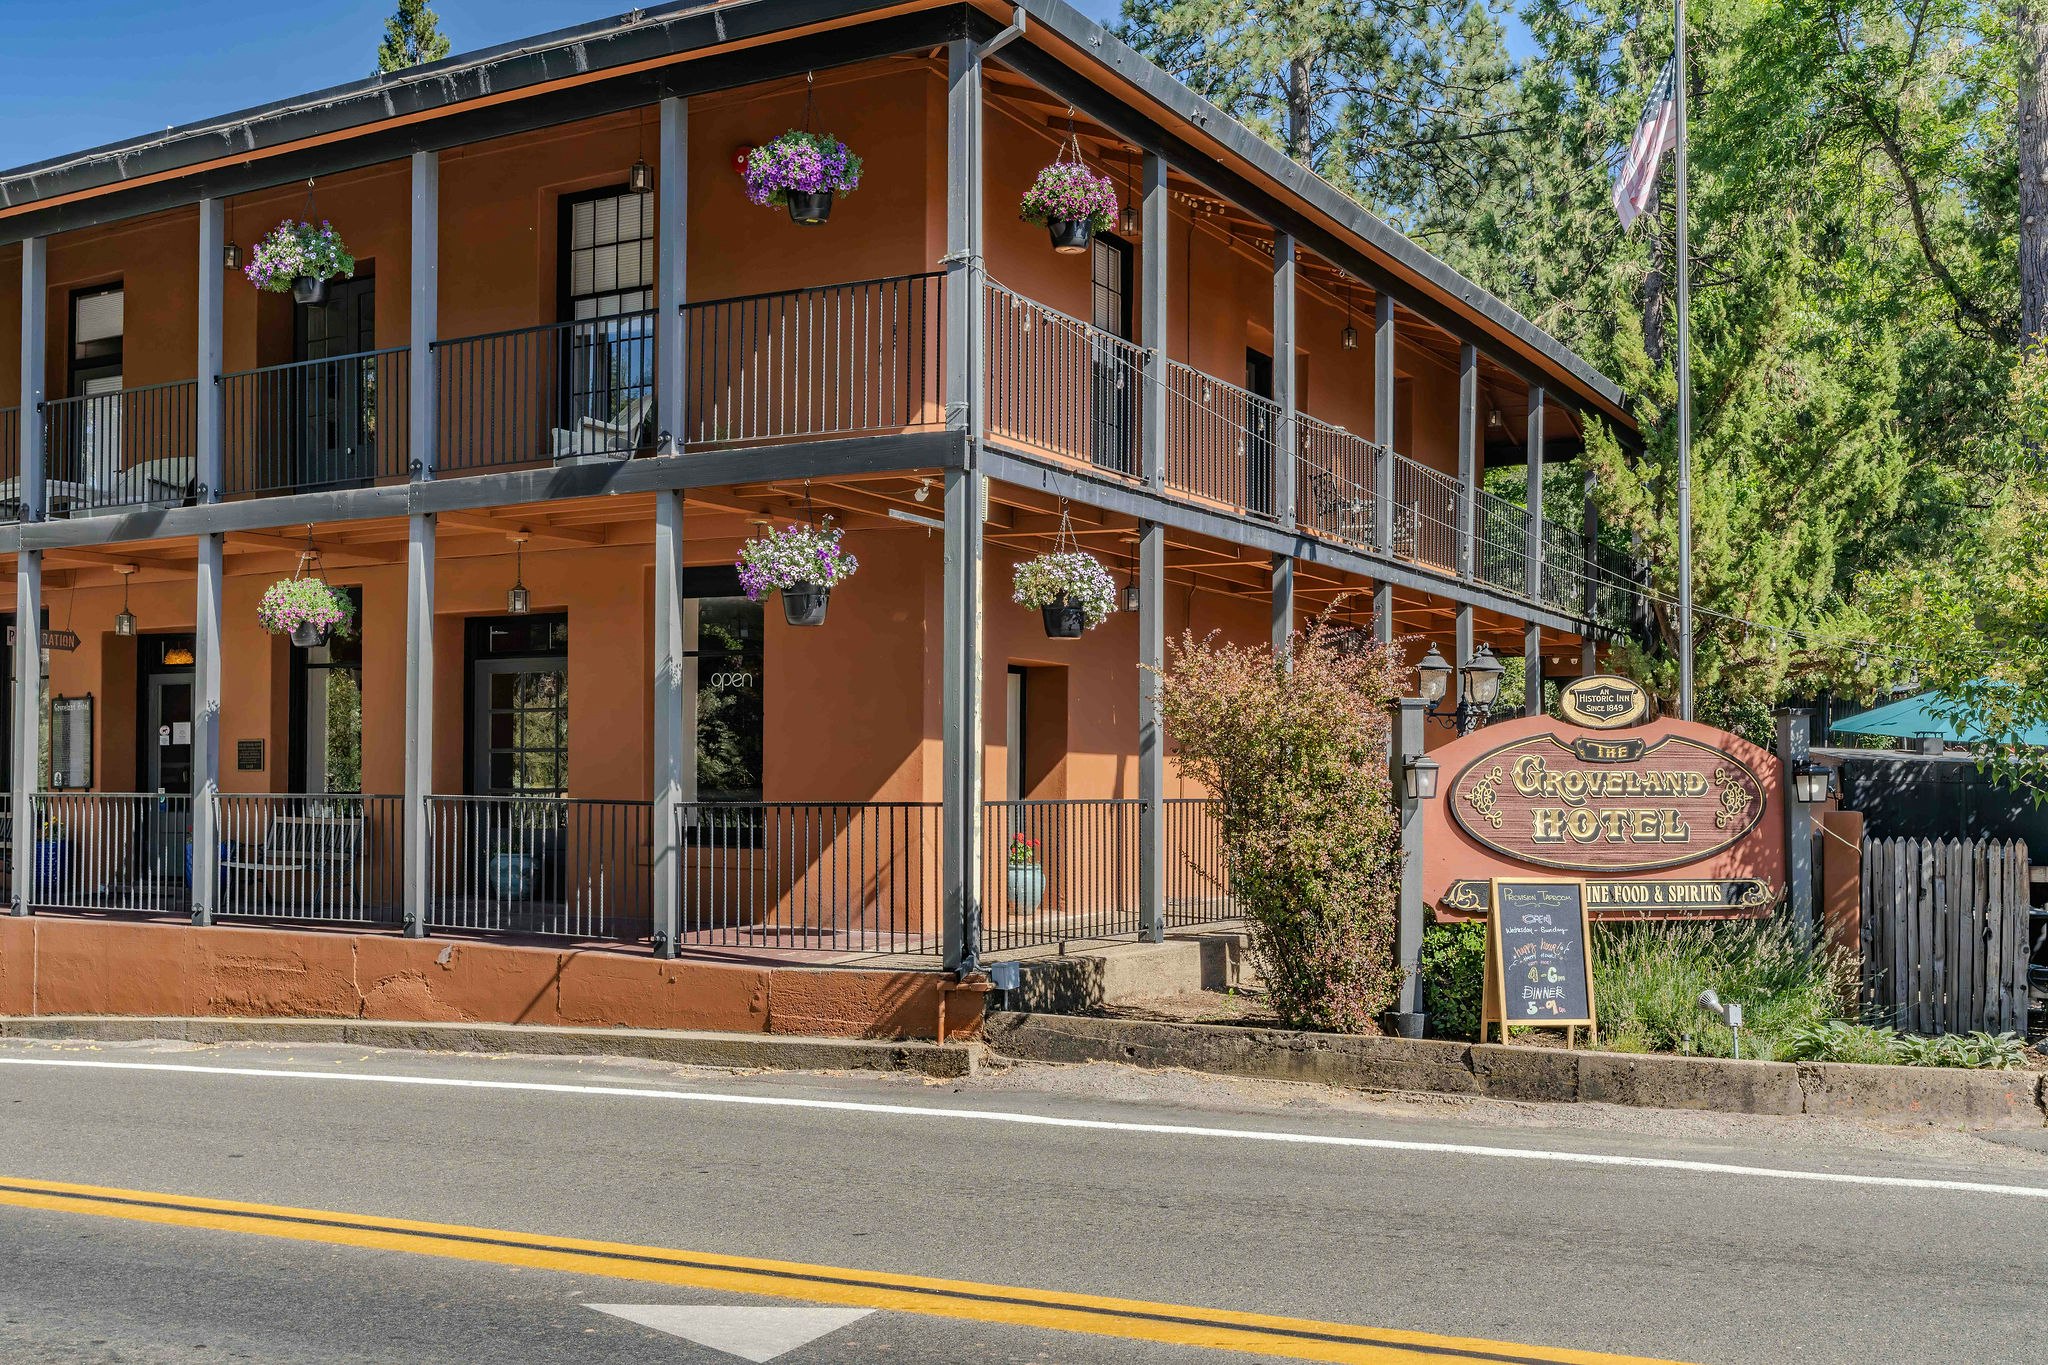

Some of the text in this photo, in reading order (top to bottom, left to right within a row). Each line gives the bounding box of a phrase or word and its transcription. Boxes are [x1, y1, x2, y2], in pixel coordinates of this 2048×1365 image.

[710, 672, 753, 691] open
[1579, 693, 1630, 703] HISTORIC INN
[1586, 704, 1624, 712] SINCE 1849
[1586, 742, 1628, 759] THE
[1510, 754, 1709, 807] GROVELAND
[1531, 808, 1691, 844] HOTEL
[1586, 884, 1721, 903] INE FOOD & SPIRITS
[1521, 985, 1566, 1000] DINNER
